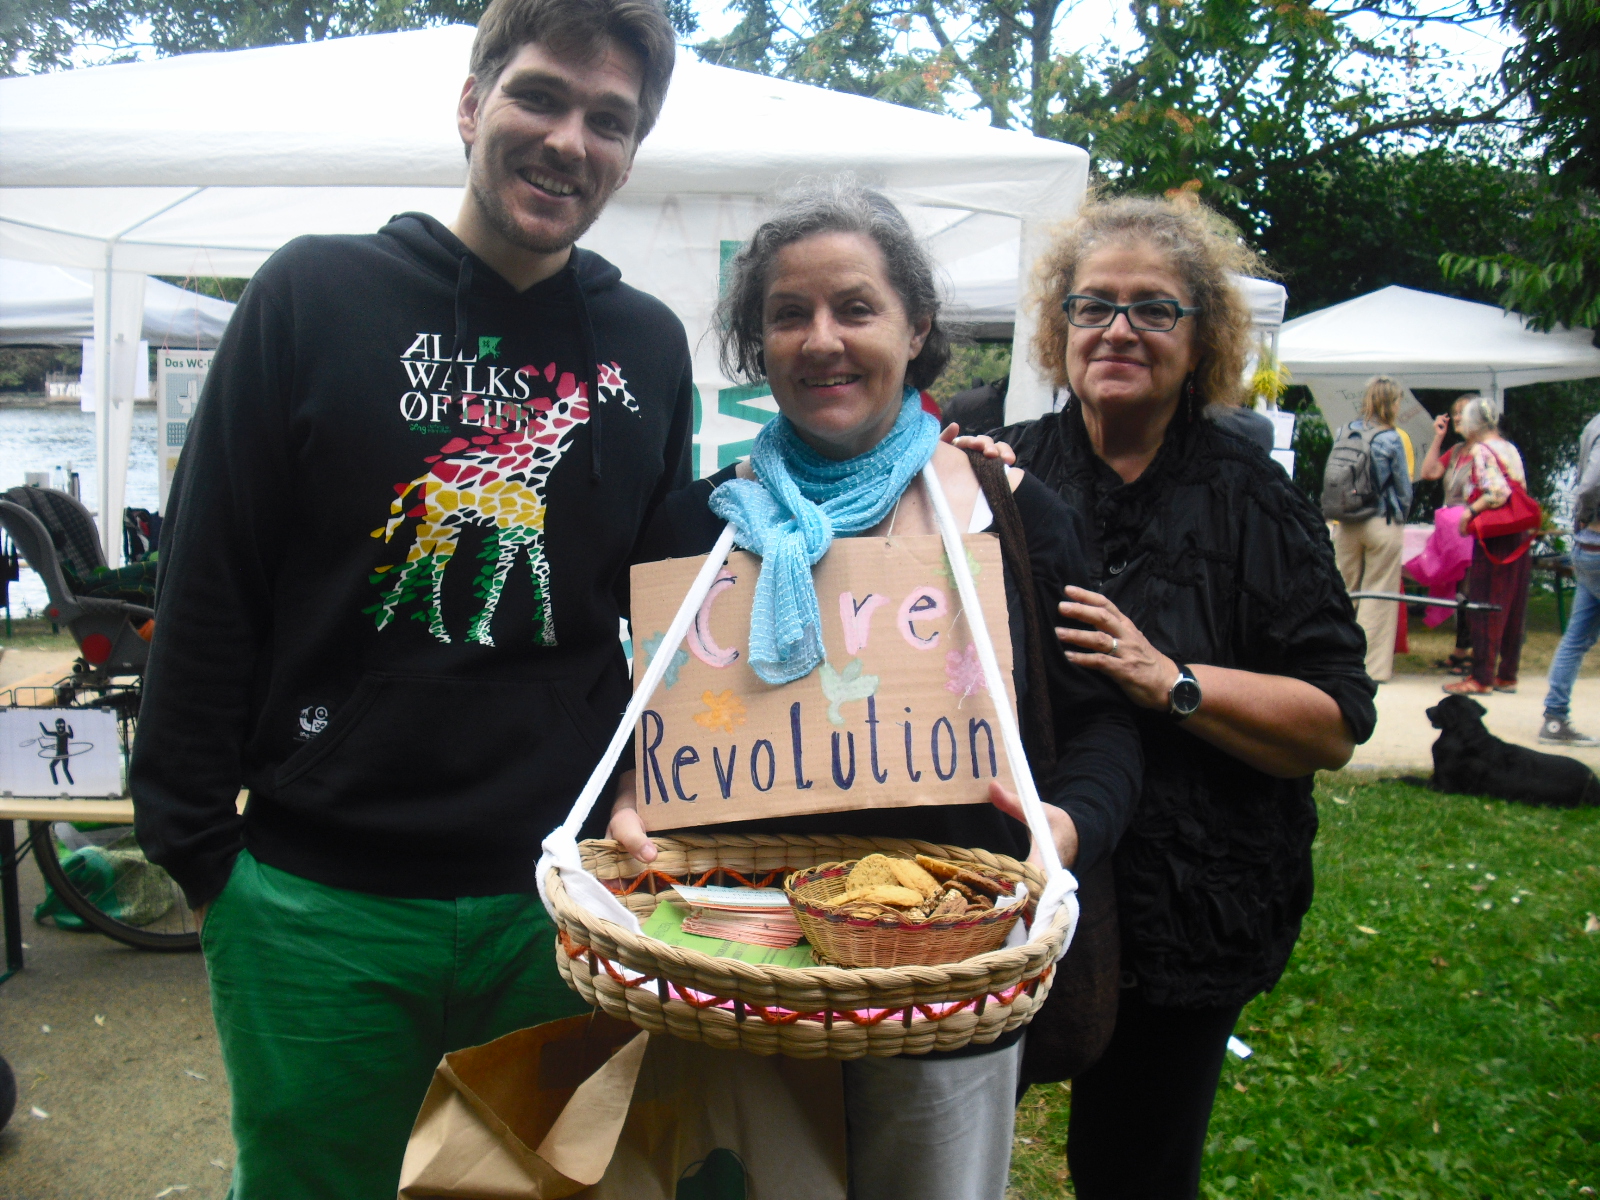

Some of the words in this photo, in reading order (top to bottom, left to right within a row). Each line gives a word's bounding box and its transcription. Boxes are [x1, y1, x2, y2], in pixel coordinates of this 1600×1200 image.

[165, 357, 184, 368] Das
[686, 567, 948, 669] Cre
[641, 693, 998, 805] Revolution
